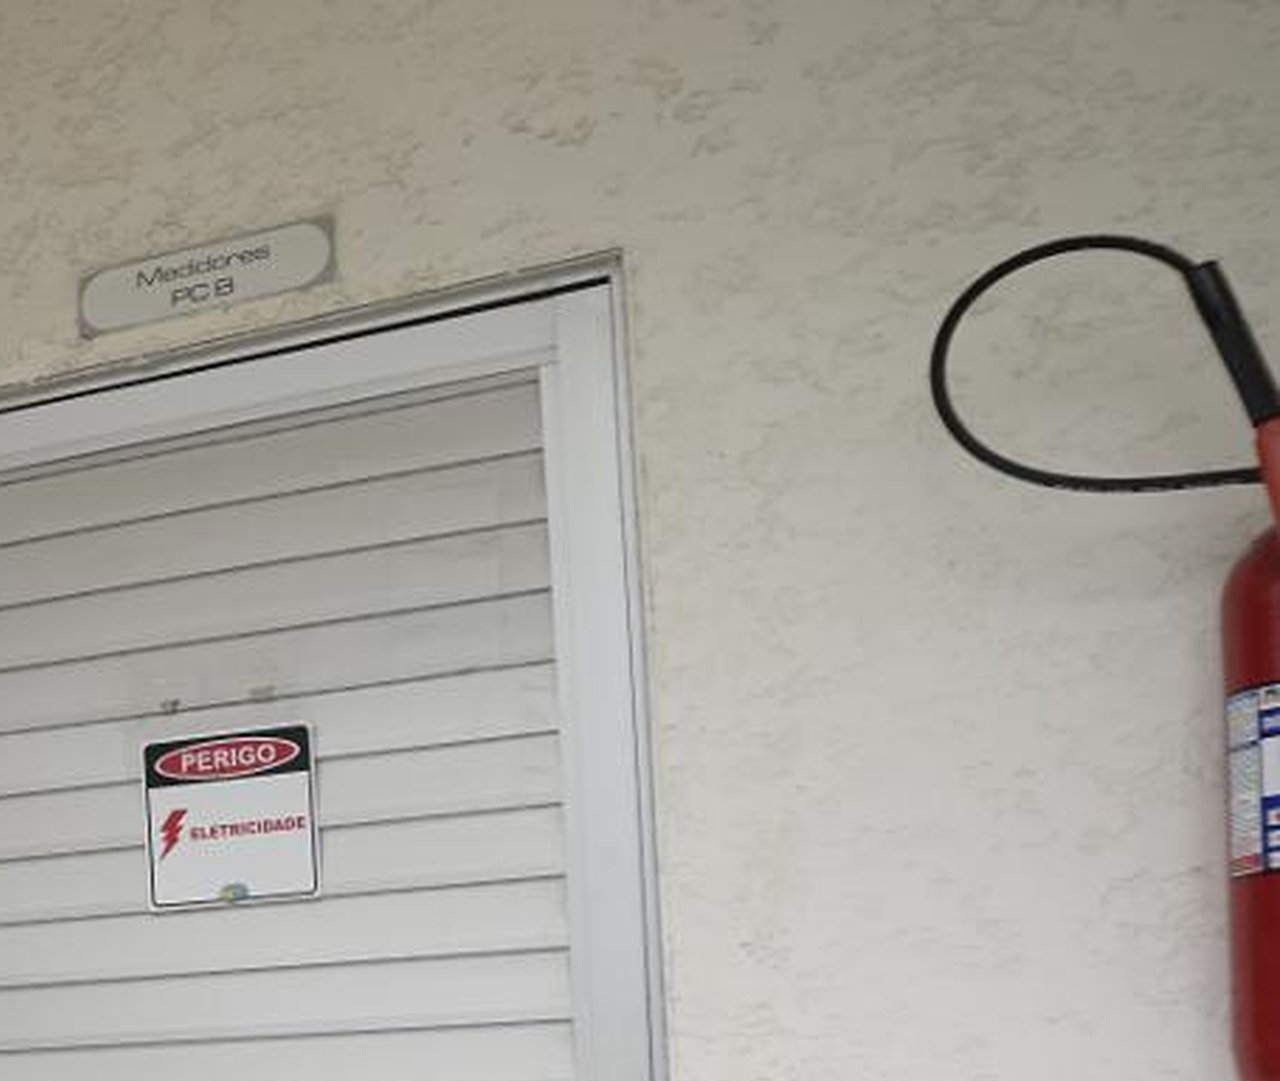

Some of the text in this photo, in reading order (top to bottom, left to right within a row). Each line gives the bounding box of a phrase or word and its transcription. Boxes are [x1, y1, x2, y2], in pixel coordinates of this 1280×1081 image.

[136, 244, 270, 288] Medidores
[180, 743, 277, 774] PERIGO
[189, 815, 307, 841] ELETRICIDADE
